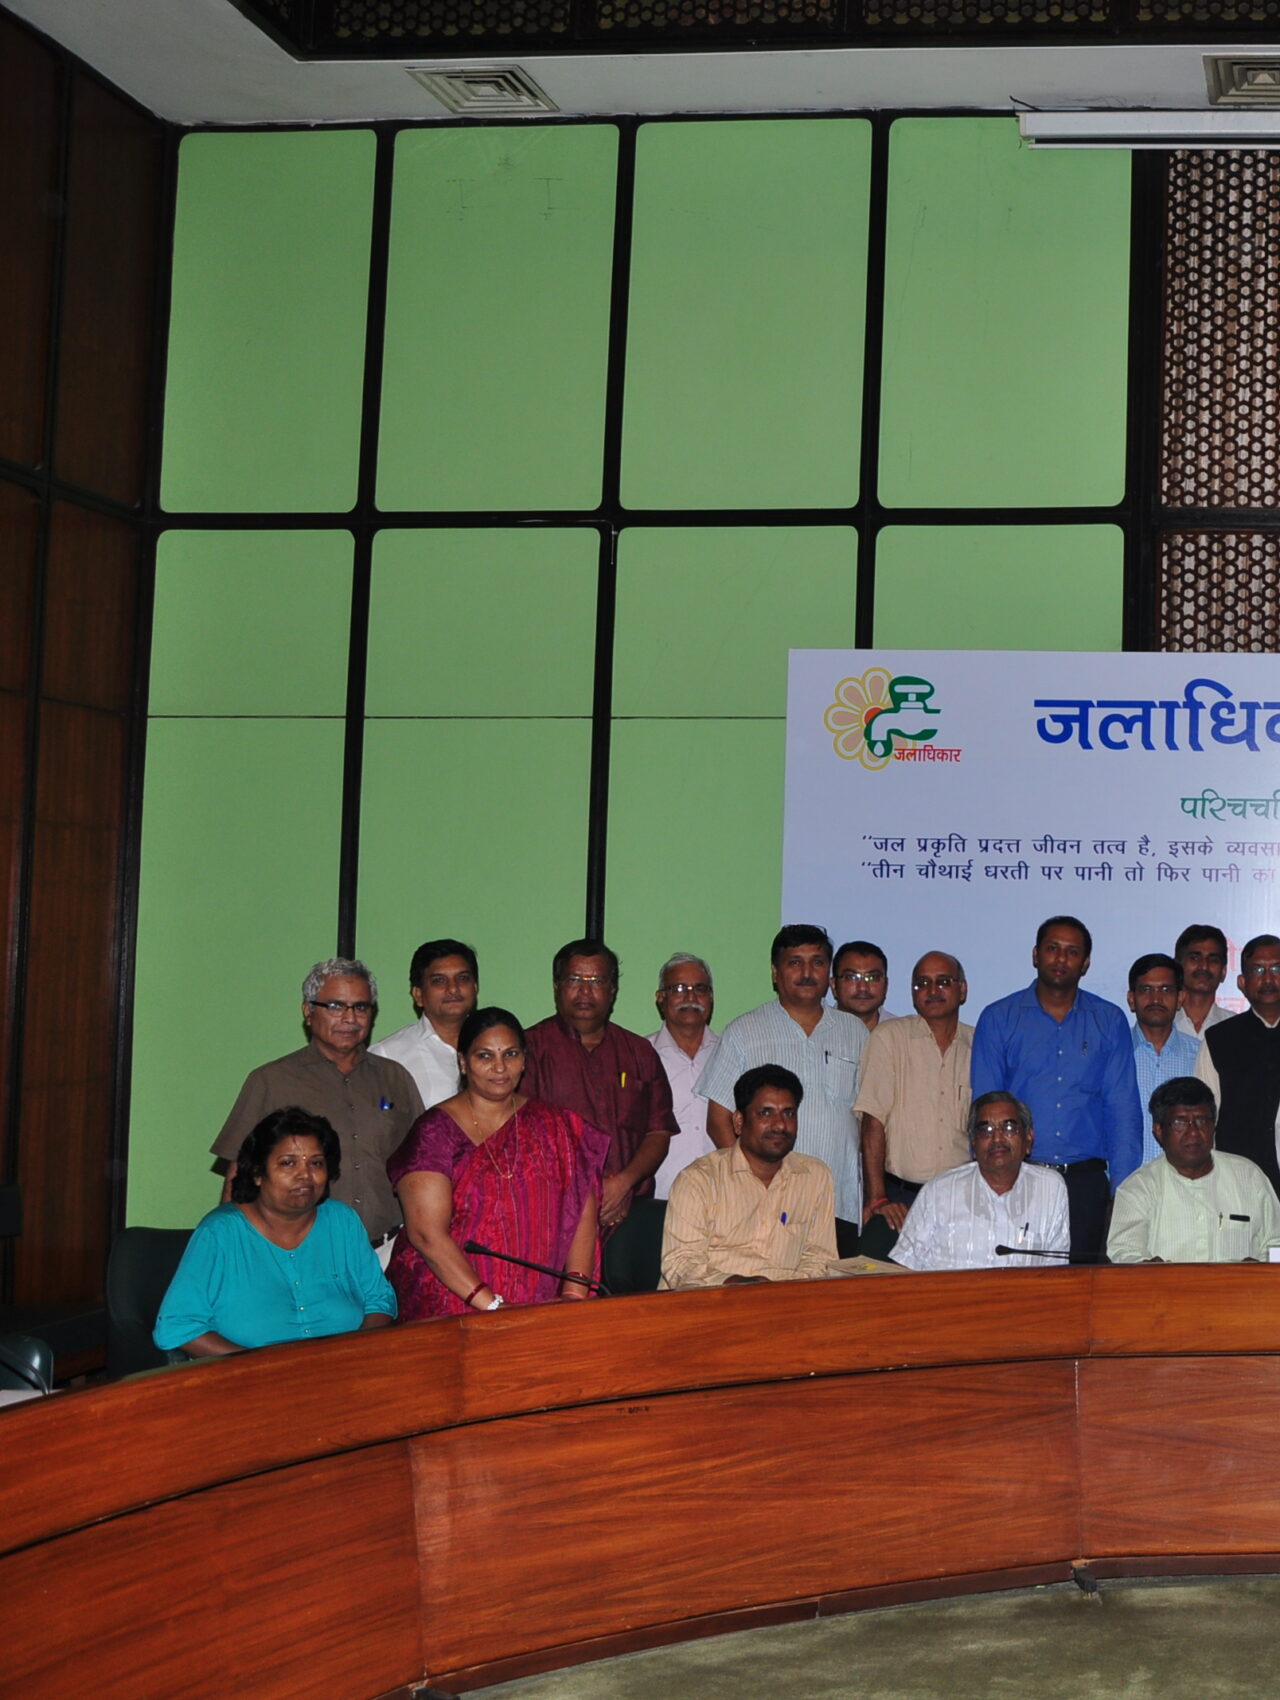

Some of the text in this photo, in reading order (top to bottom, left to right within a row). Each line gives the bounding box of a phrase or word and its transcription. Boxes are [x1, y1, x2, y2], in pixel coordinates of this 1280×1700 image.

[894, 744, 963, 763] जलाधिकार
[916, 832, 967, 858] प्रकृति
[978, 838, 1023, 854] प्रदत्त
[1031, 833, 1082, 855] जीवन
[1092, 839, 1128, 855] तत्व
[1168, 834, 1214, 858] इसके
[915, 858, 974, 882] चौथाई
[984, 860, 1031, 881] धरती
[1040, 865, 1064, 881] पर
[1073, 860, 1114, 882] पानी
[1123, 861, 1145, 882] तो
[1152, 861, 1191, 883] फिर
[1201, 862, 1241, 884] पानी
[1252, 868, 1276, 884] का
